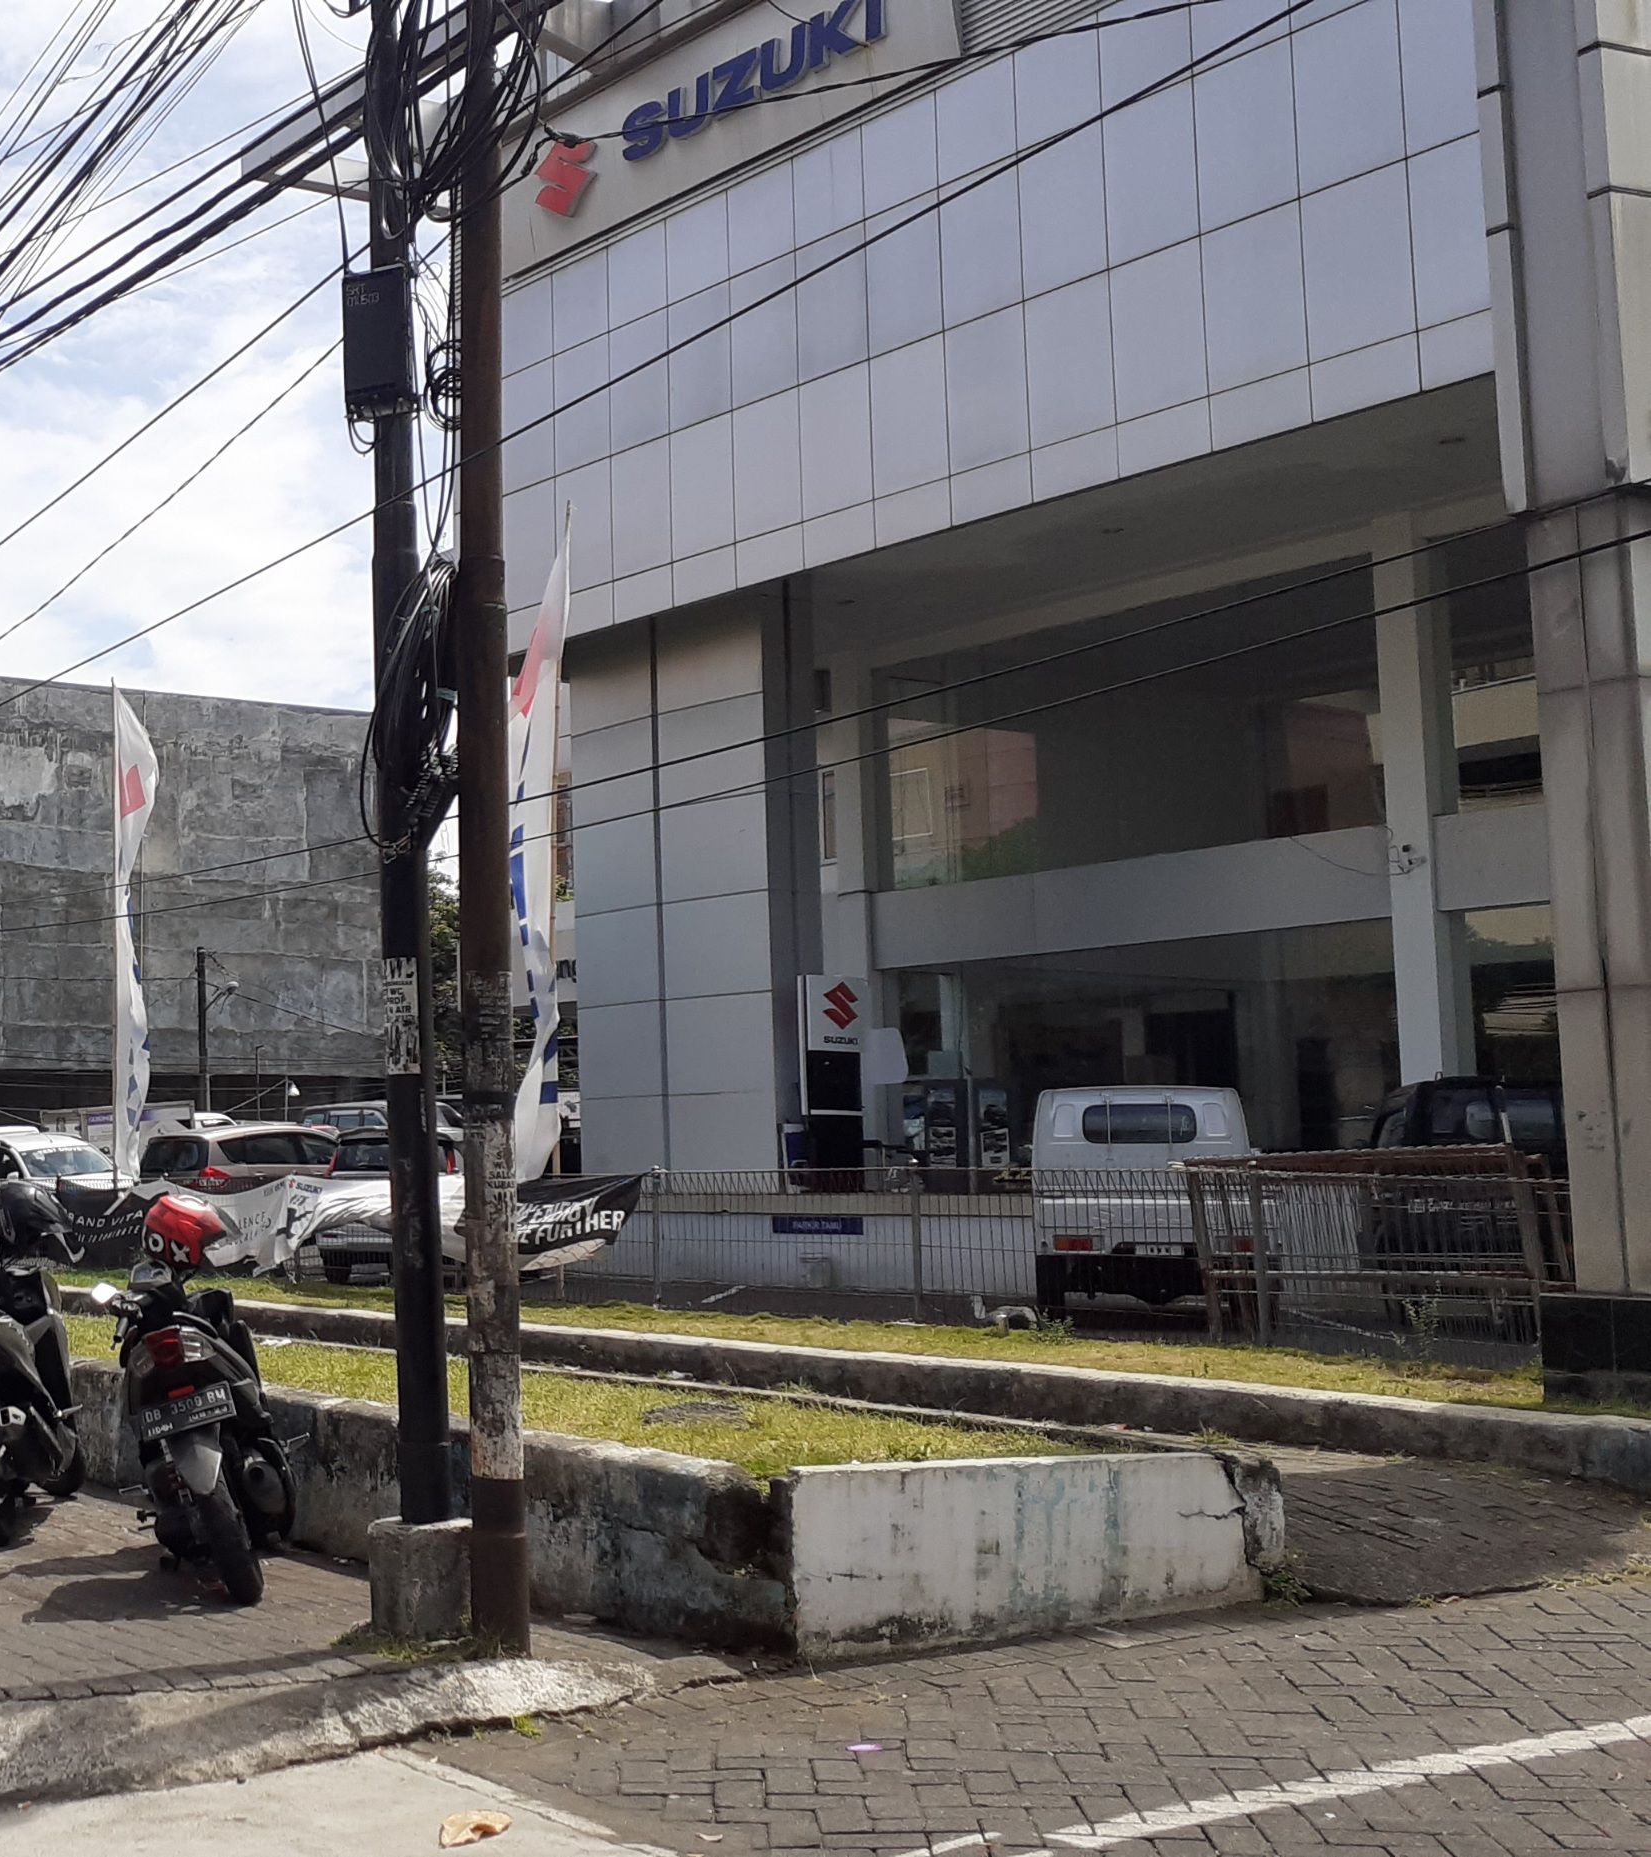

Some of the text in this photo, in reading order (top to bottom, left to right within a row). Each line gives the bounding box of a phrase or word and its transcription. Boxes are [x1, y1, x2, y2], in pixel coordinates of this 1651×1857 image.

[621, 0, 886, 161] SUZUKI
[823, 1035, 859, 1046] SUZUKI
[535, 1210, 626, 1245] FURTHER
[145, 1409, 162, 1423] DB
